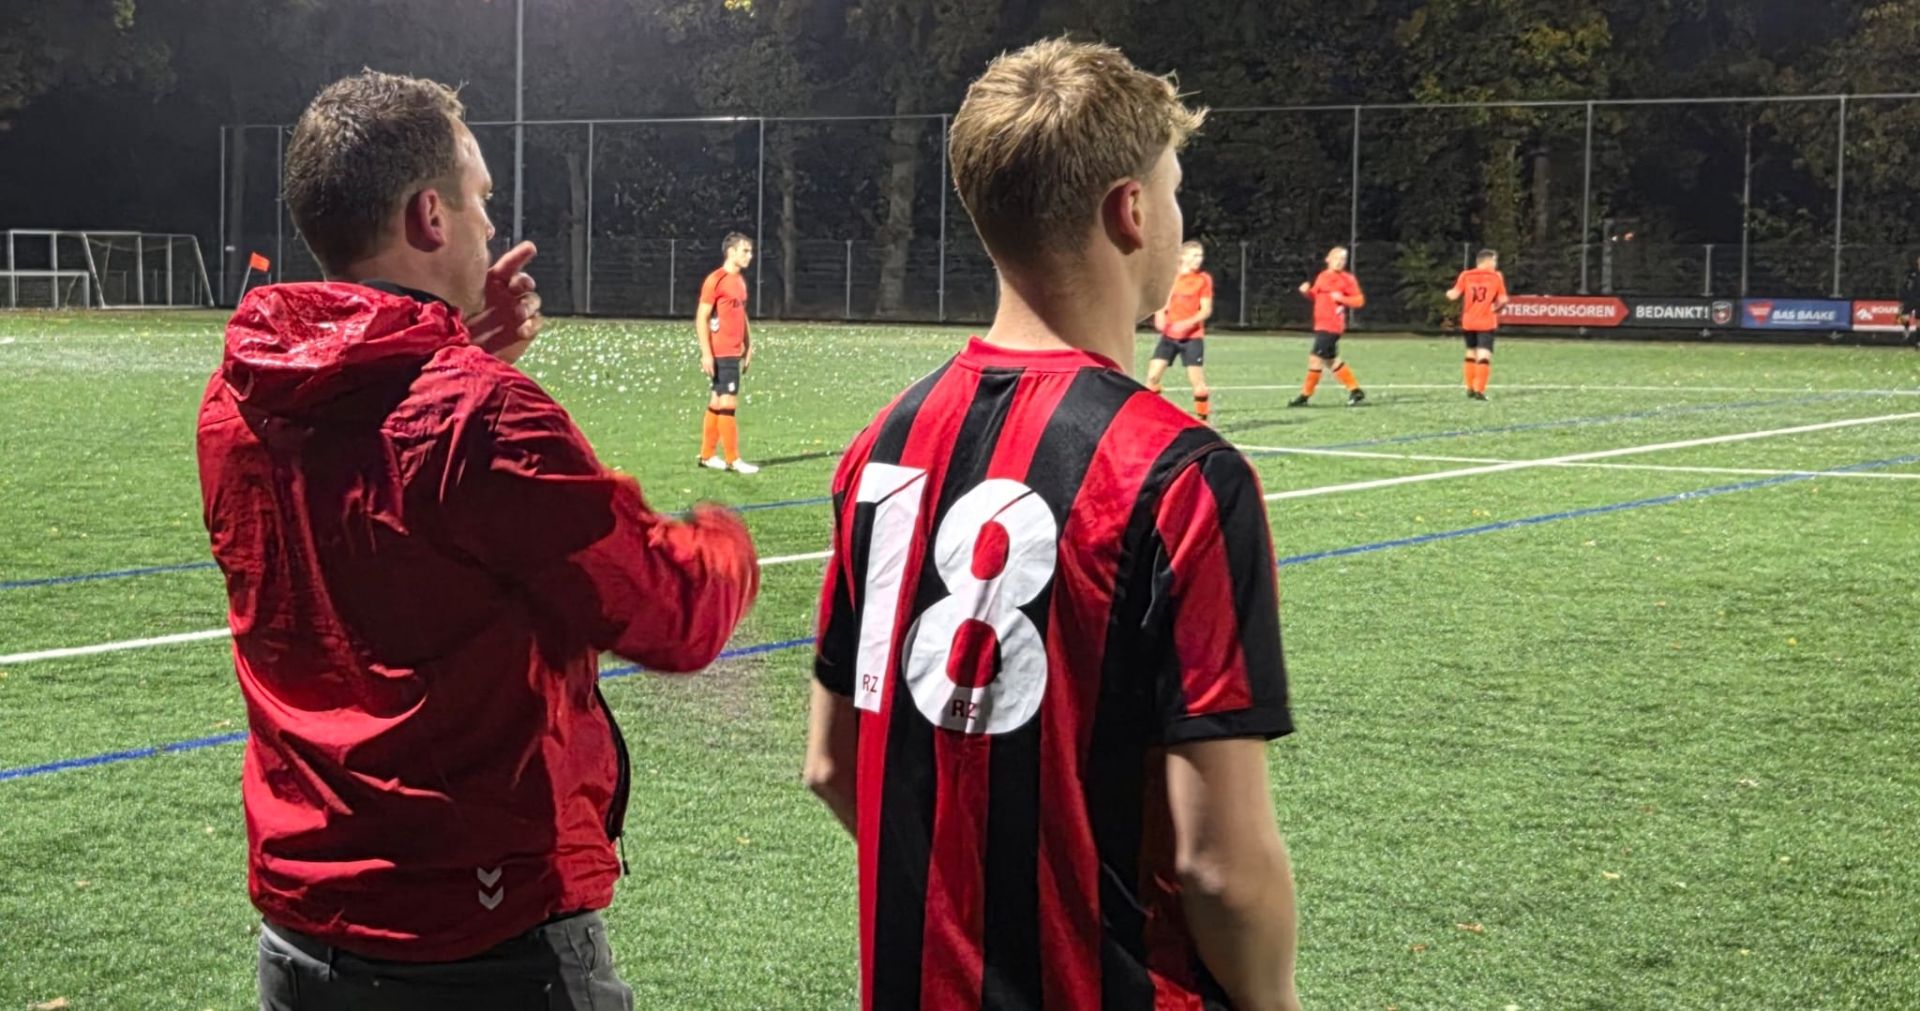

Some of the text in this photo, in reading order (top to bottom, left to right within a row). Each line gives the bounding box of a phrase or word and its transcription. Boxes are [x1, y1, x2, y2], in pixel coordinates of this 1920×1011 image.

[1635, 305, 1709, 319] BEDANKT!
[1772, 310, 1796, 320] BAS
[854, 462, 1057, 734] 18
[862, 674, 879, 693] RZ
[951, 700, 977, 719] RZ
